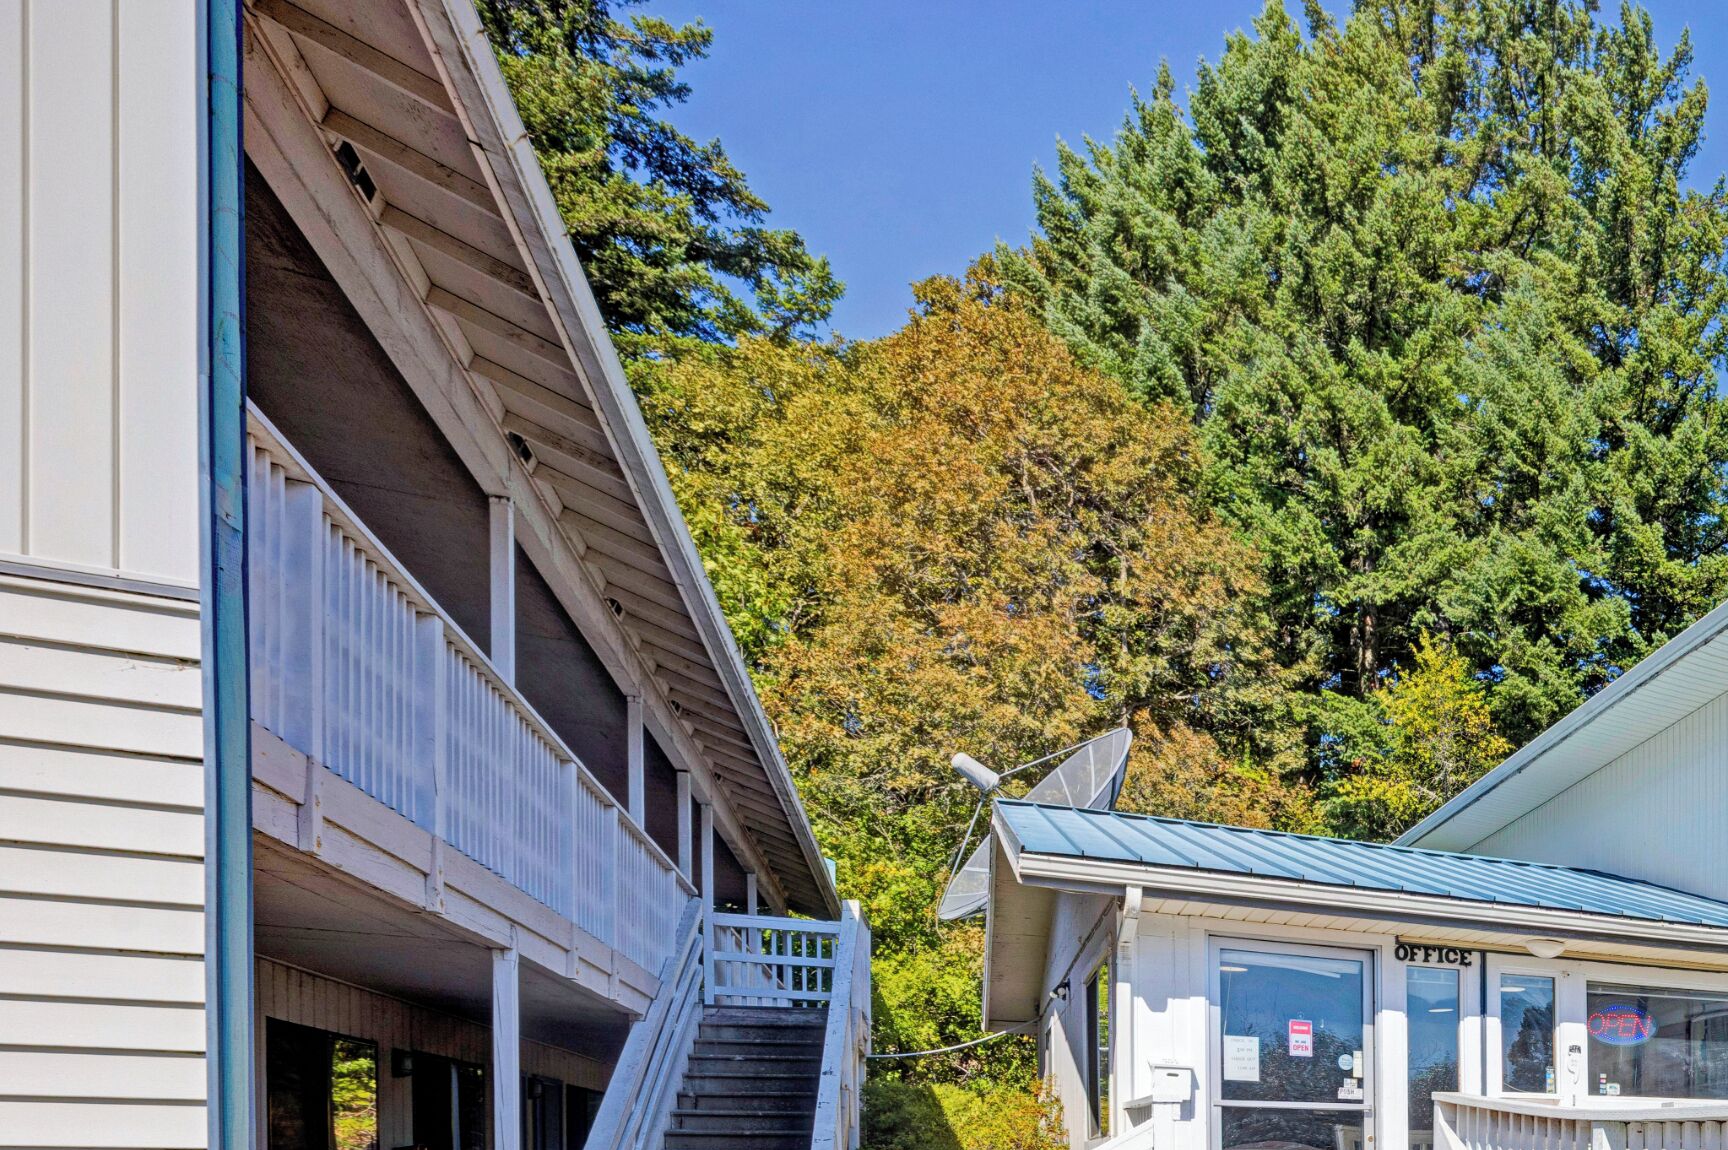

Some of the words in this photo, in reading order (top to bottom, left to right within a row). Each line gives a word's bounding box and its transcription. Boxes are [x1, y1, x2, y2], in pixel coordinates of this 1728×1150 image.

[1394, 944, 1473, 967] OFFICE
[1587, 1012, 1652, 1038] OPEN
[1293, 1044, 1309, 1052] OPEN
